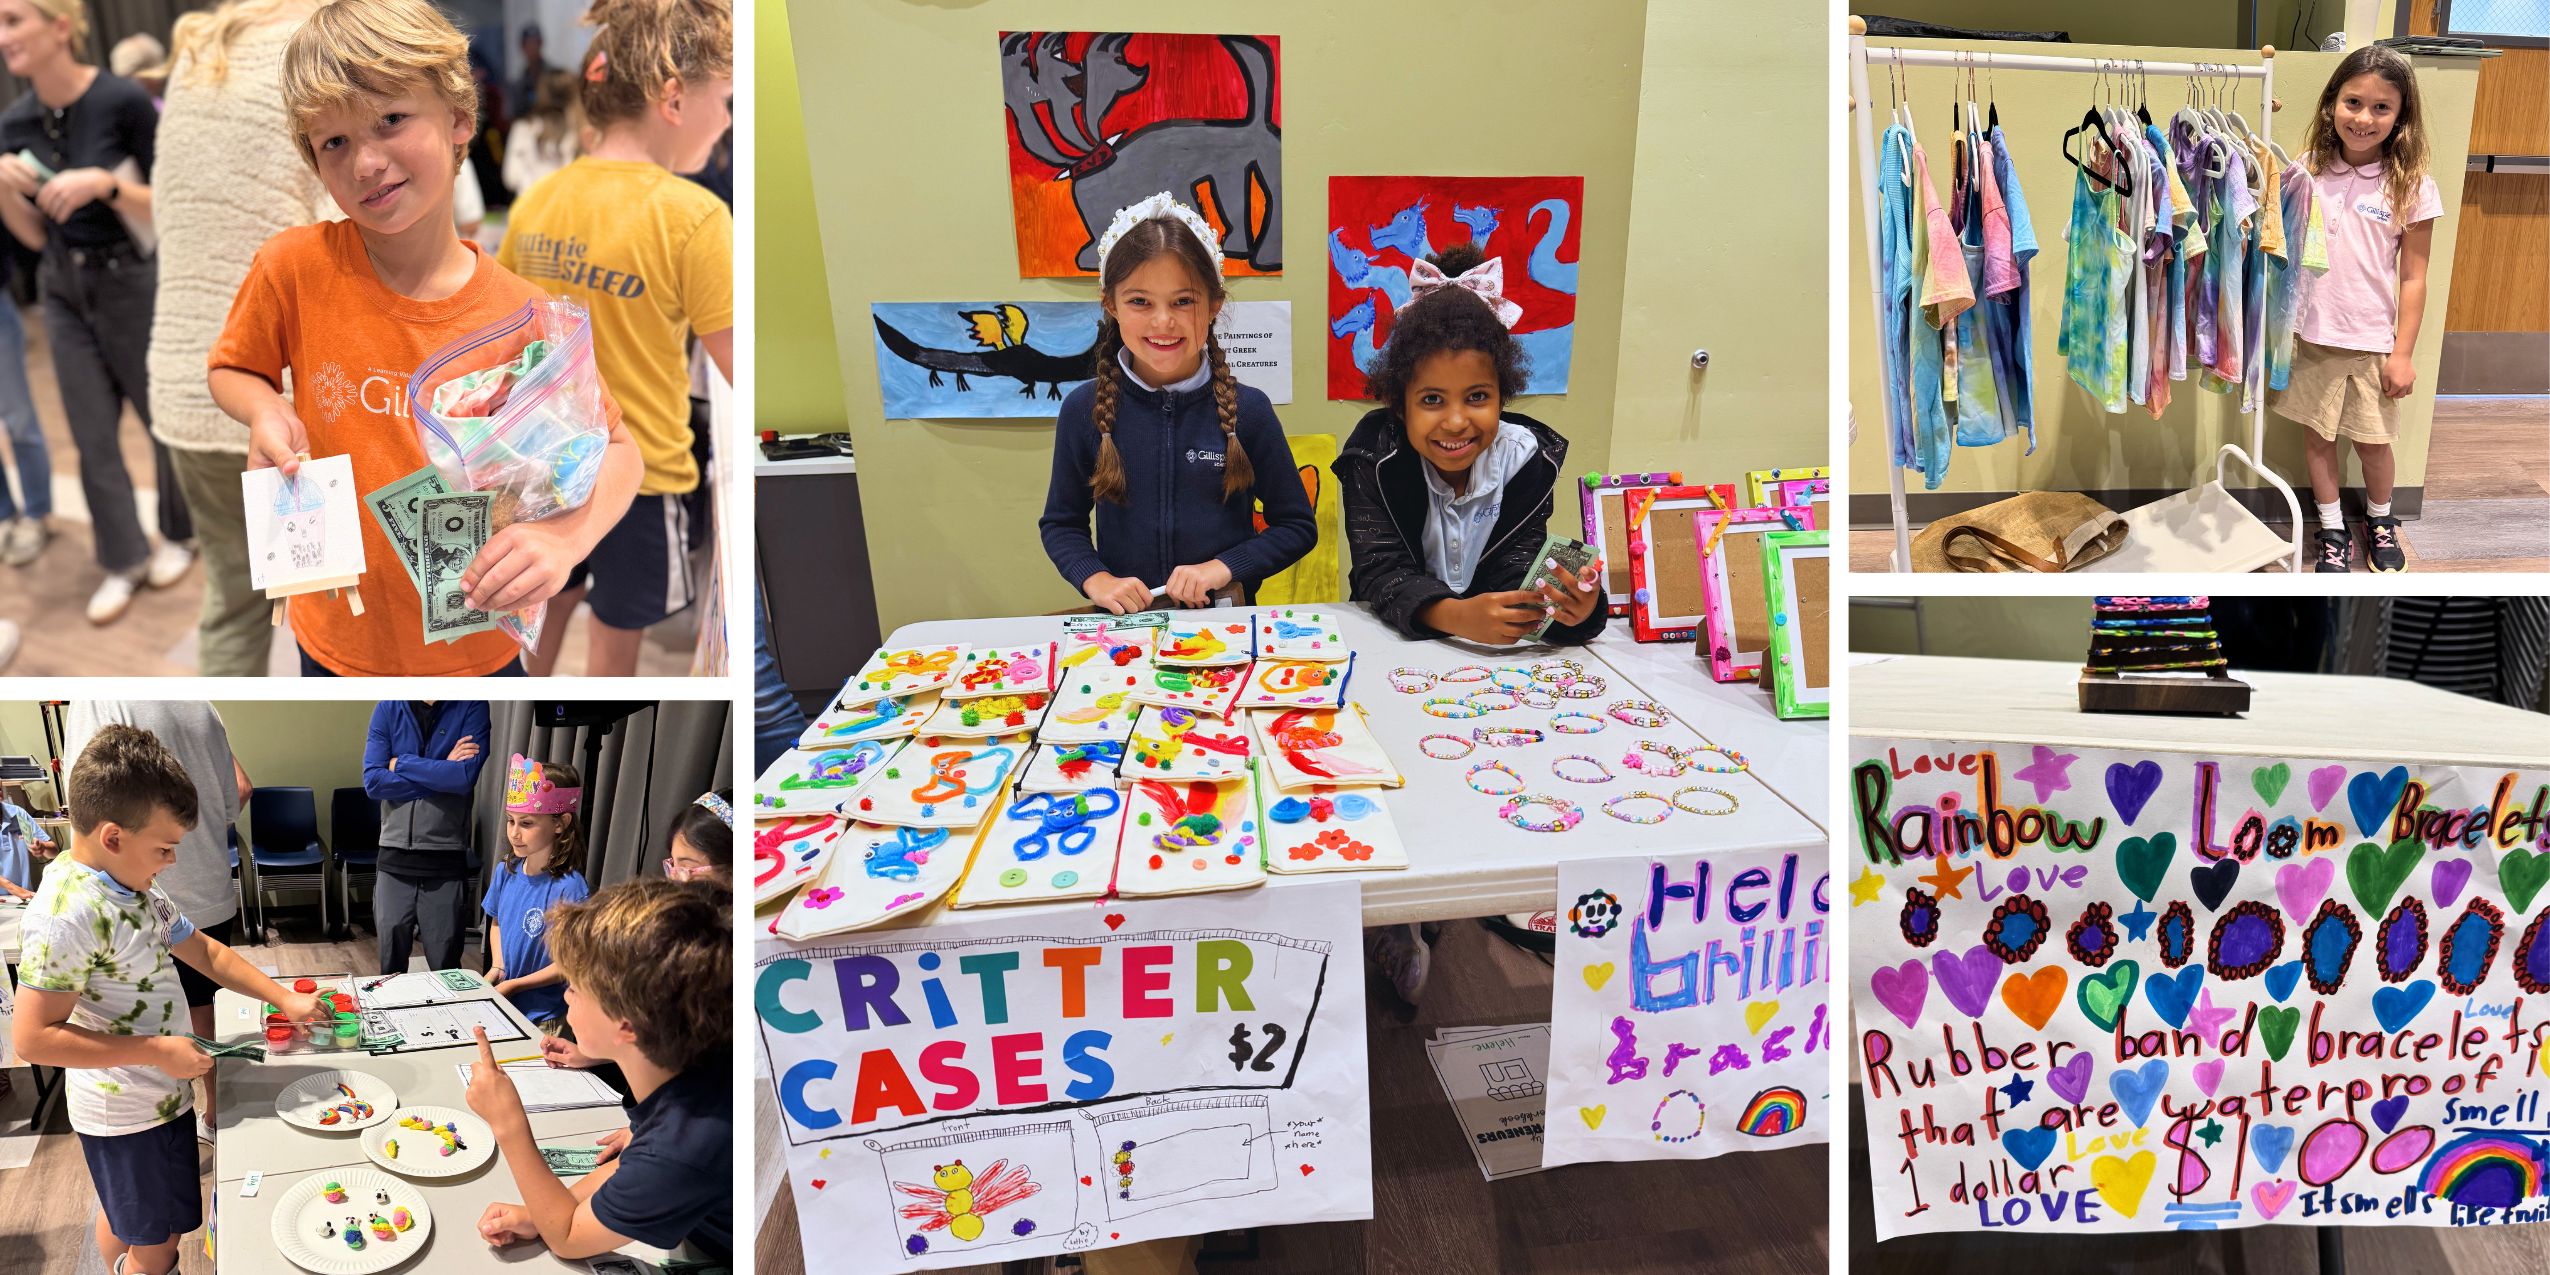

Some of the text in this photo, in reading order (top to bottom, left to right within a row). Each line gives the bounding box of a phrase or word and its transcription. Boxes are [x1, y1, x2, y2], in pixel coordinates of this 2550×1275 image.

[360, 376, 410, 418] Gil
[1198, 450, 1225, 463] Gillisp
[1889, 747, 1979, 780] Love
[1852, 751, 2106, 867] Rainbow
[2191, 761, 2346, 864] Loom
[1976, 861, 2088, 902] Love
[1629, 912, 1829, 1013] brilli
[2464, 998, 2516, 1019] Love
[1228, 1023, 1287, 1073] $2
[1472, 1036, 1516, 1053] Helene
[1863, 997, 2550, 1097] Rubber band bracelets
[780, 1029, 1116, 1130] CASES
[1145, 1096, 1170, 1106] Back
[1499, 1109, 1546, 1127] orkbook
[941, 1119, 970, 1131] front
[1294, 1130, 1320, 1138] name
[1898, 1087, 2006, 1158] that
[2040, 1101, 2119, 1132] are
[2065, 1125, 2149, 1162] Love
[1899, 1157, 2077, 1217] 1 dollar
[1978, 1187, 2102, 1227] LOVE
[1079, 1229, 1090, 1237] by
